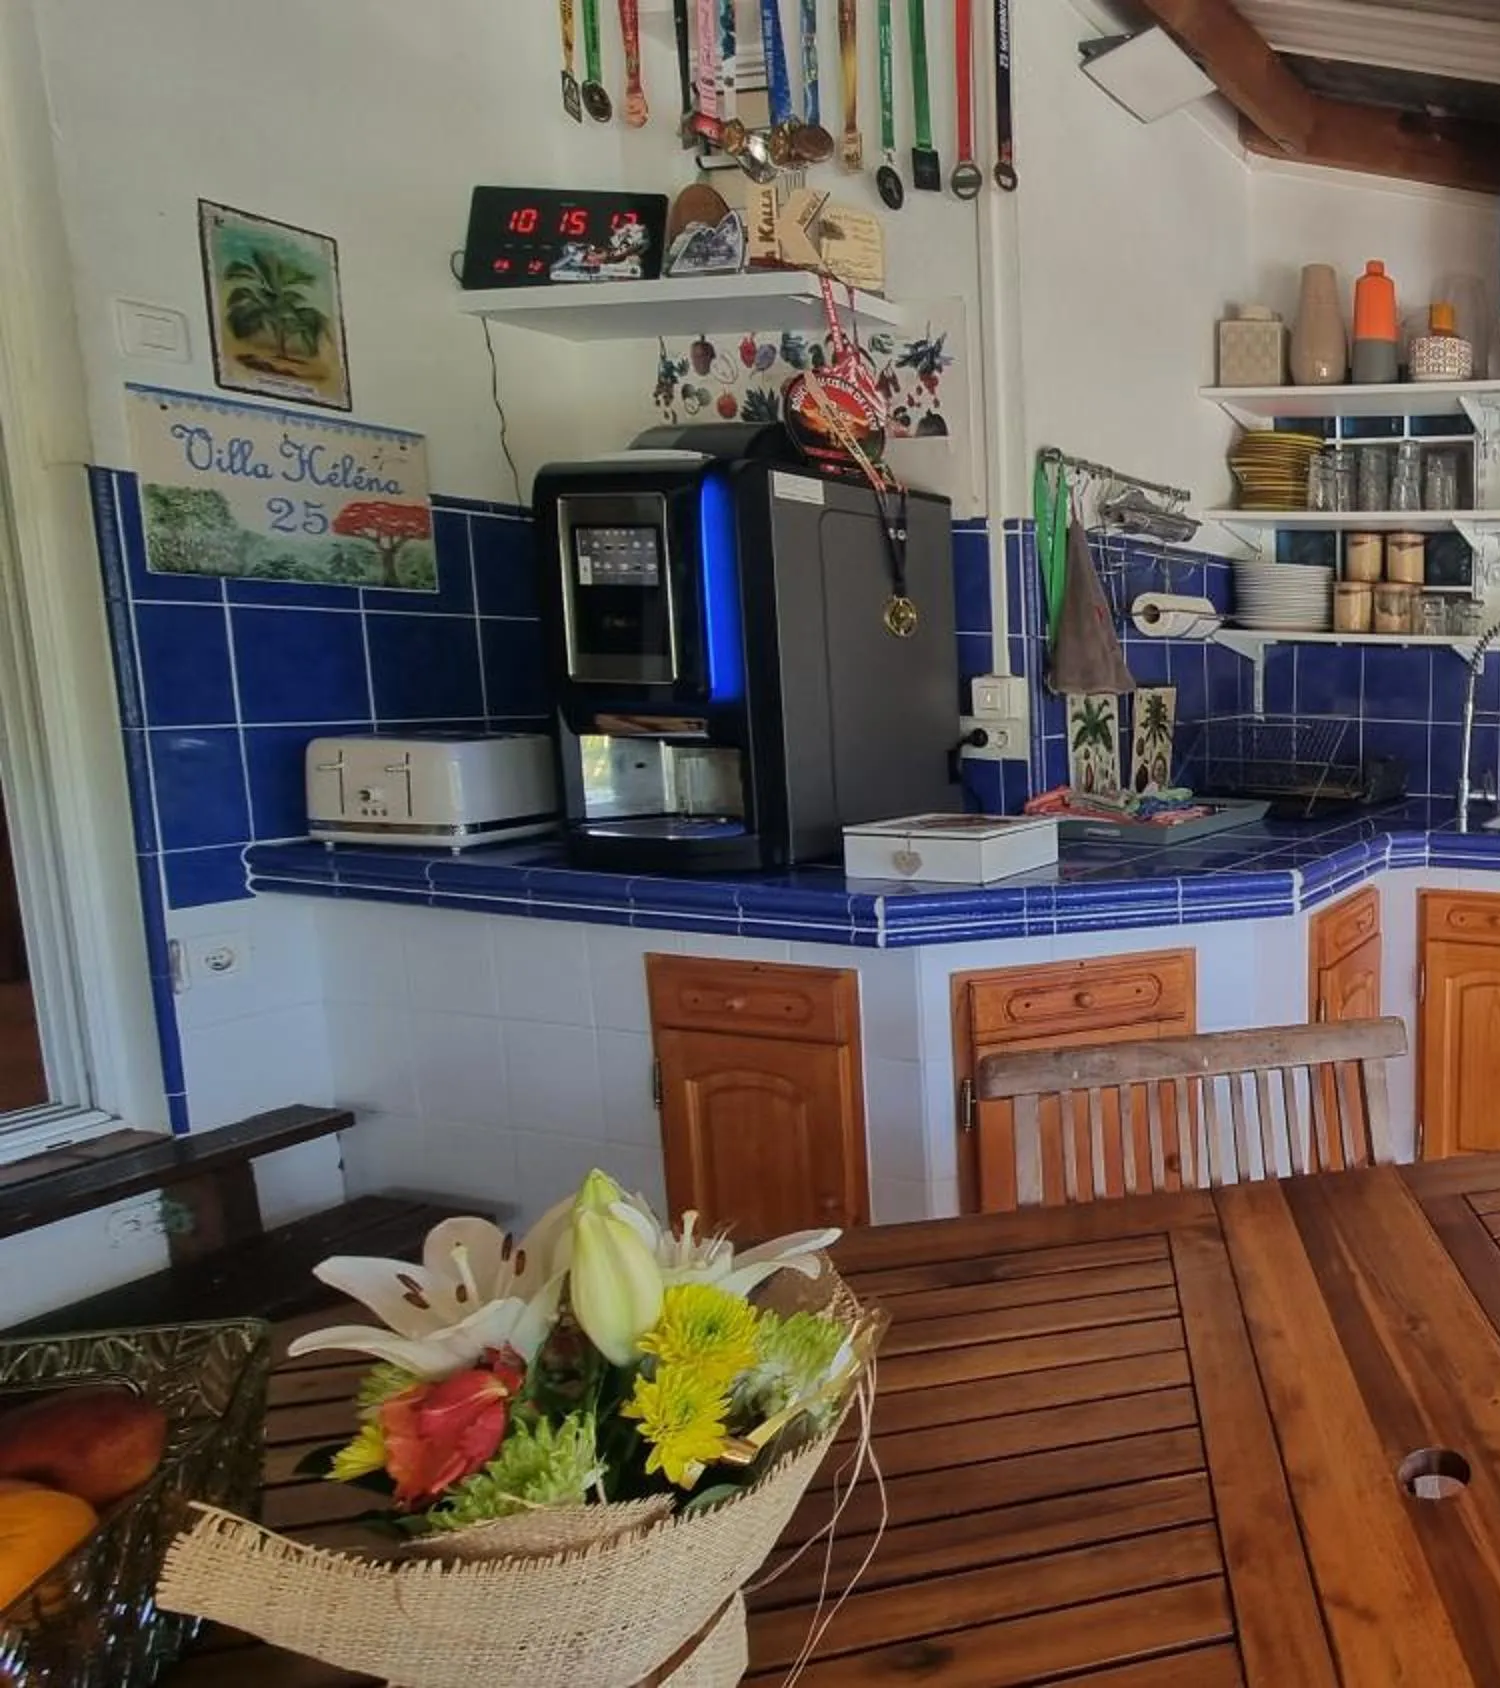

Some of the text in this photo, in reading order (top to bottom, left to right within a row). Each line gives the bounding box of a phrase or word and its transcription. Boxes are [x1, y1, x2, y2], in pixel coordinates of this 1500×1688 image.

[508, 208, 538, 234] 10
[559, 210, 589, 236] 15
[169, 423, 274, 479] Villa
[266, 497, 329, 535] 25
